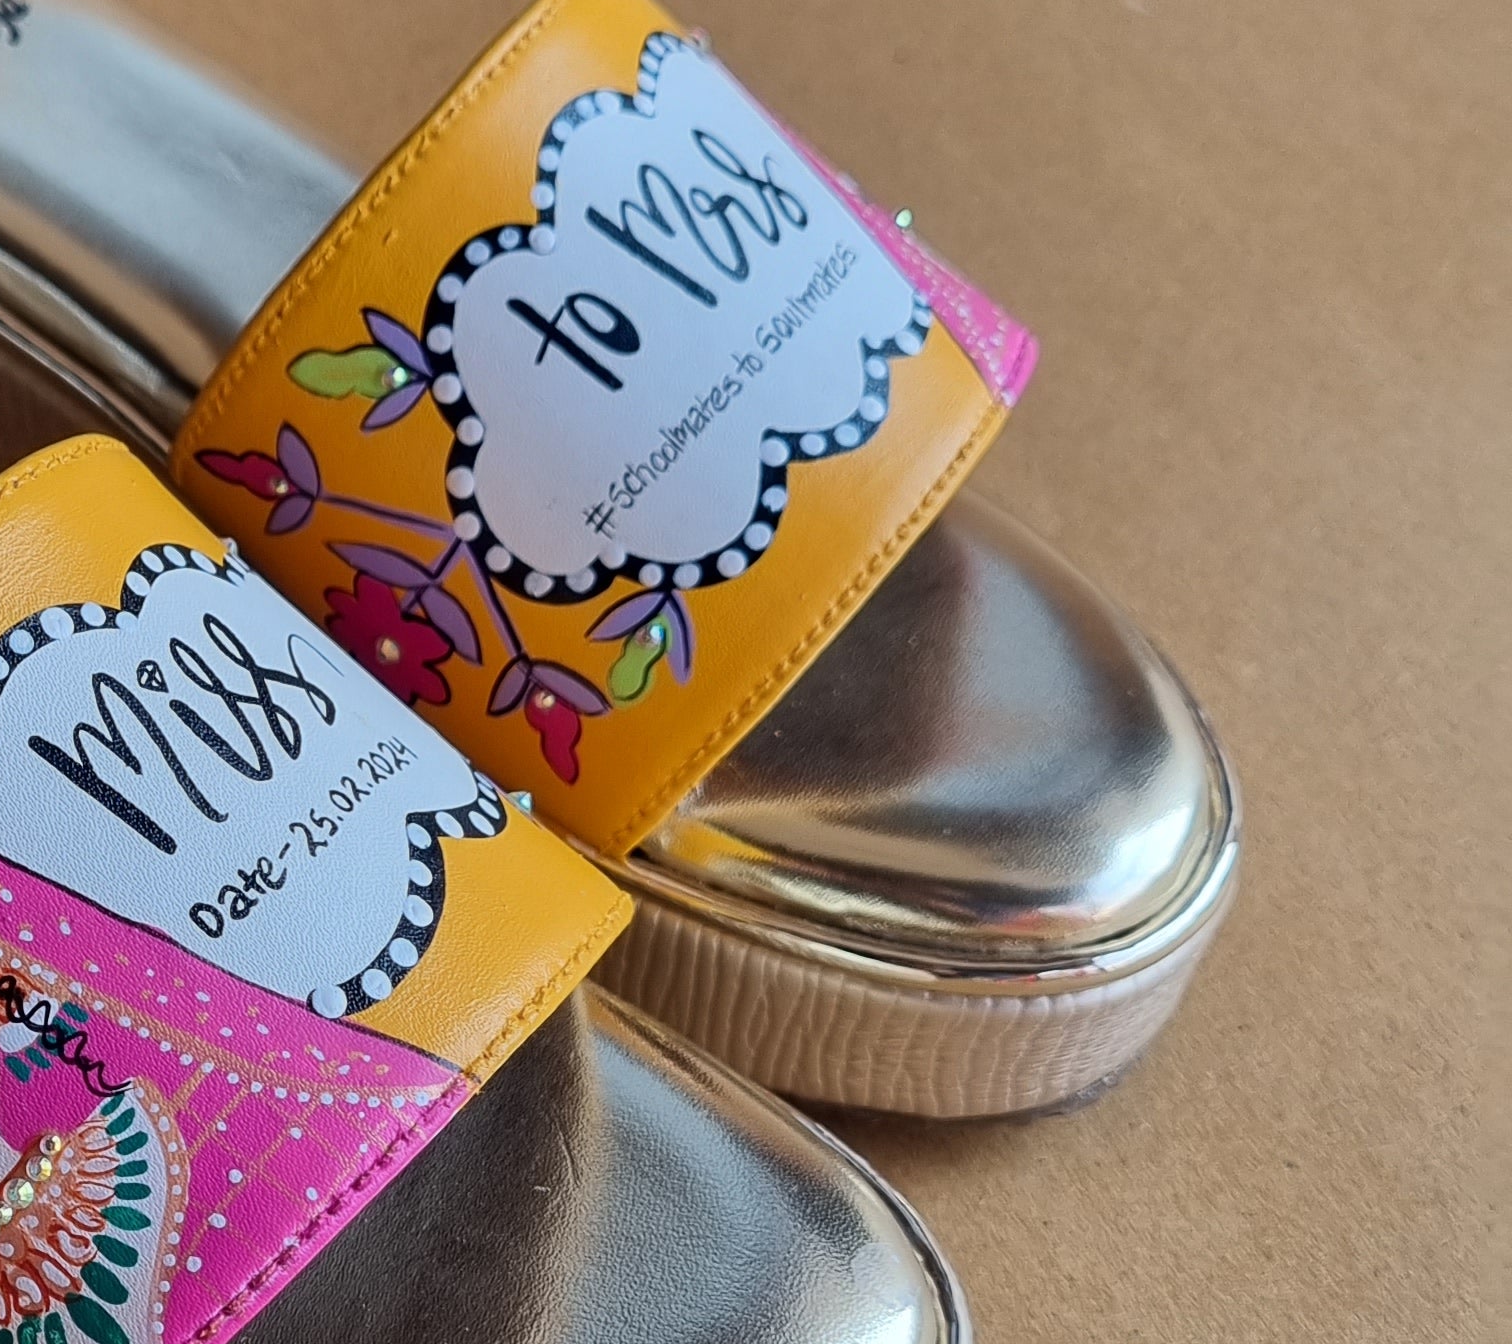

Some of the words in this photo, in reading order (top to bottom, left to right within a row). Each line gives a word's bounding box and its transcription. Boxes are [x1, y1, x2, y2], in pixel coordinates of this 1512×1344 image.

[508, 292, 642, 392] to
[585, 128, 808, 309] Mrs
[732, 351, 765, 391] to
[28, 613, 345, 855] Miss
